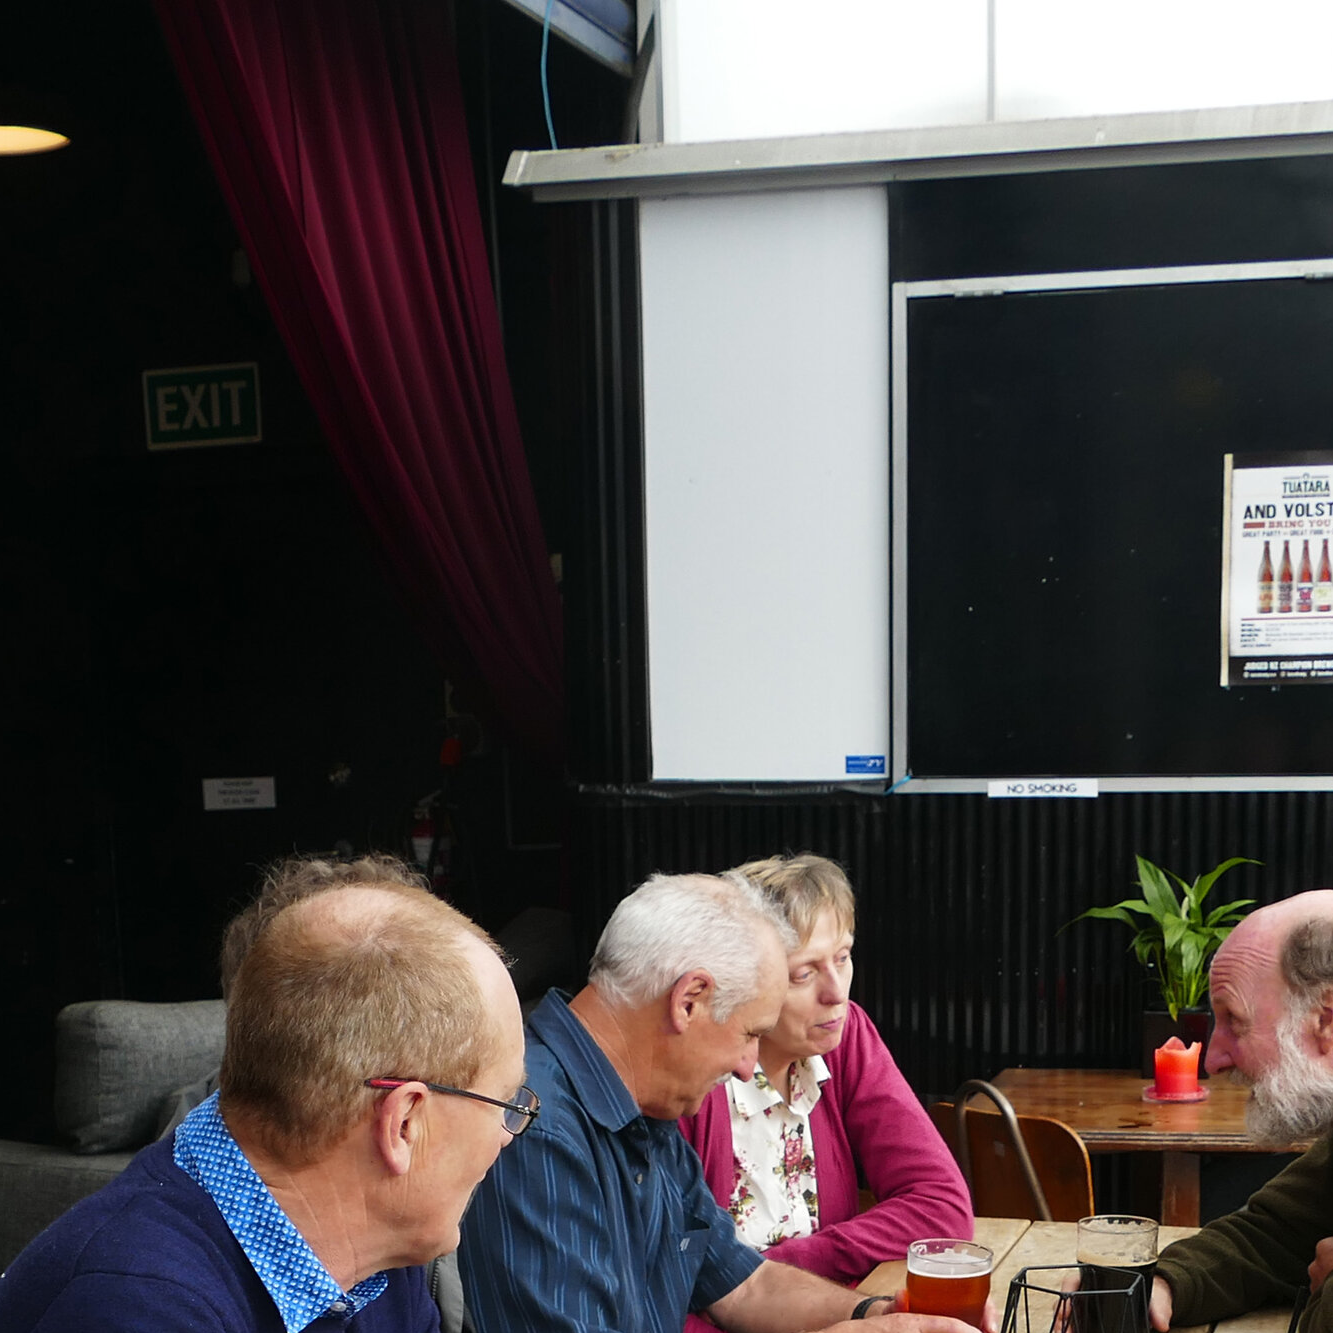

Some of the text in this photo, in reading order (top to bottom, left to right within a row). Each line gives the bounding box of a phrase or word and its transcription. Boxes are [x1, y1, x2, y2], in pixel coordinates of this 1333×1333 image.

[156, 381, 247, 431] EXIT
[1283, 480, 1330, 494] TUATARA
[1243, 504, 1277, 519] AND
[1268, 520, 1304, 528] BRING
[1309, 519, 1331, 527] YOU
[1007, 783, 1077, 794] NO SMOKING
